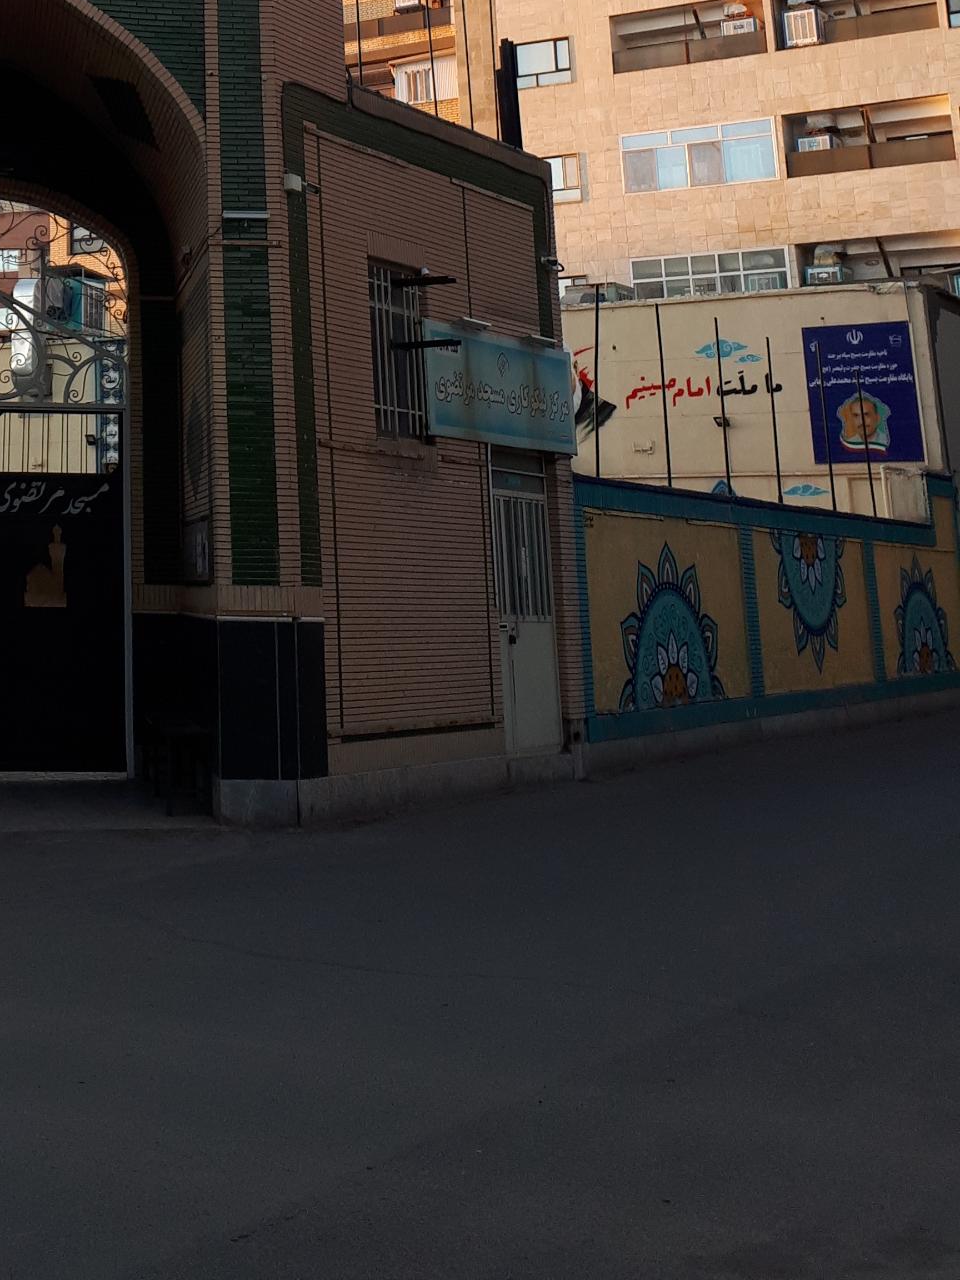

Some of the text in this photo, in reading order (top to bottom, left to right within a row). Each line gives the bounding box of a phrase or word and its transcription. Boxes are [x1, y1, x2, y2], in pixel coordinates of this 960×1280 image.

[435, 371, 475, 405] مرتضوی
[477, 381, 505, 408] مسجد
[673, 376, 710, 407] امام
[765, 373, 782, 394] ما
[550, 390, 569, 422] مرکز
[63, 482, 110, 514] مسجد
